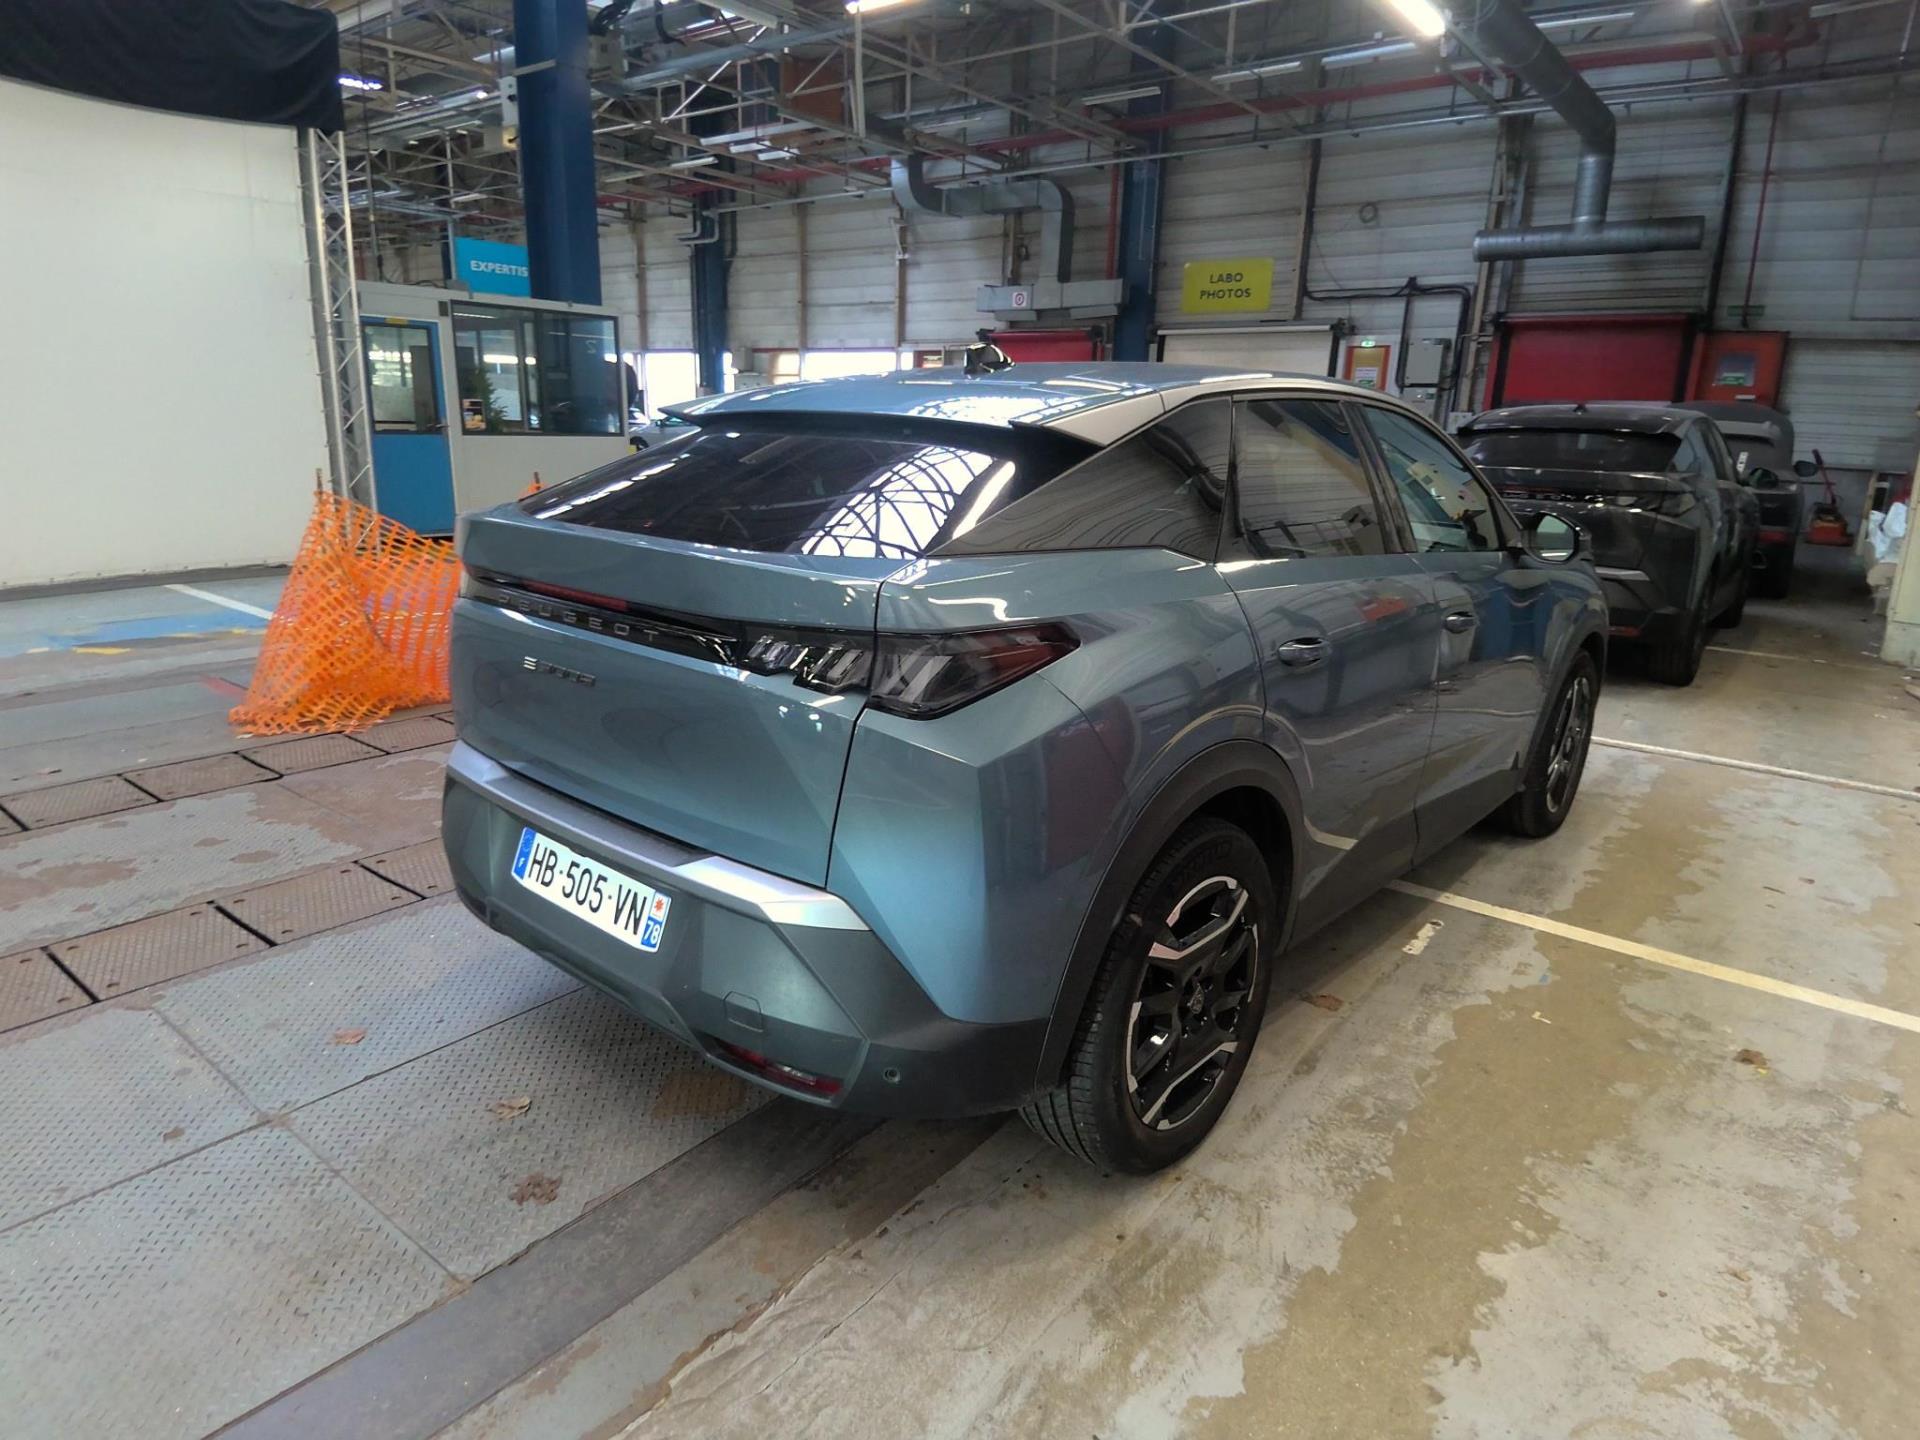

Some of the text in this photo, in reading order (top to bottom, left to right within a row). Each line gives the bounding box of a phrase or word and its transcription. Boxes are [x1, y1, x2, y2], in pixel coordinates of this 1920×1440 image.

[1209, 272, 1244, 284] LABO
[1200, 288, 1252, 300] PHOTOS
[499, 595, 660, 641] PEUGEOT
[643, 919, 661, 945] 78
